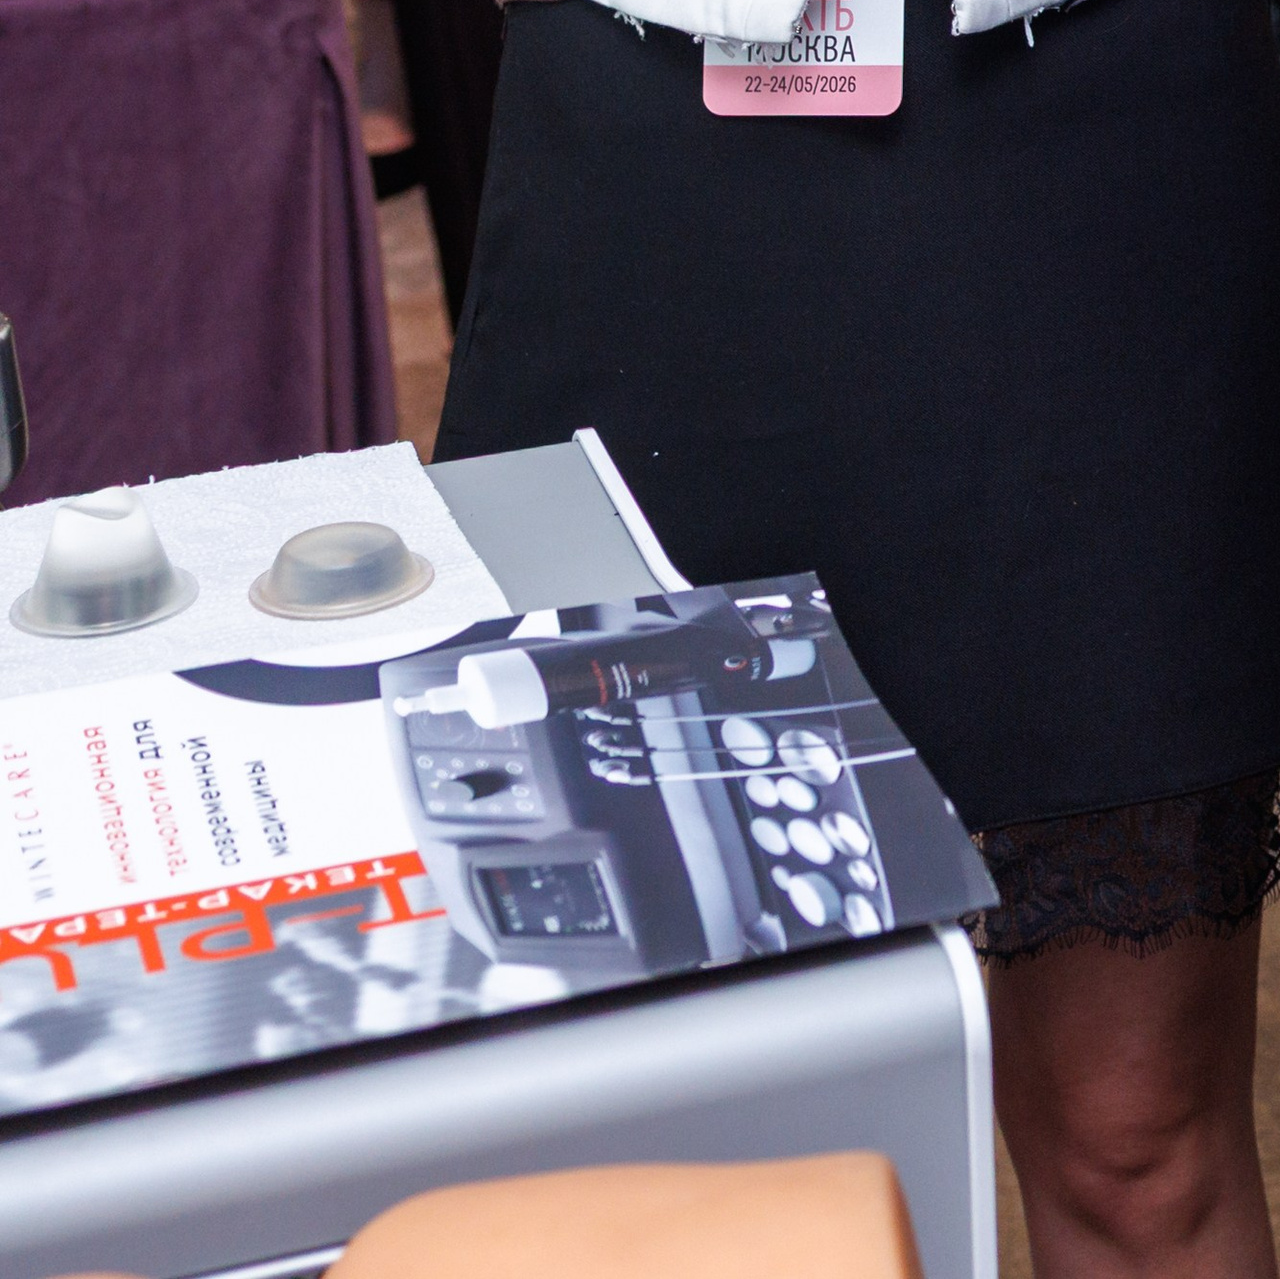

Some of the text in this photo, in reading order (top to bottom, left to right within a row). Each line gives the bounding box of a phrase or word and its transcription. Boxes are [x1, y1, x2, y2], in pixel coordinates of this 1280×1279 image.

[745, 74, 857, 95] 22-24/05/2026
[83, 726, 138, 884] инновационная
[133, 718, 190, 878] технология для
[180, 735, 242, 867] современной
[244, 759, 291, 858] медицины
